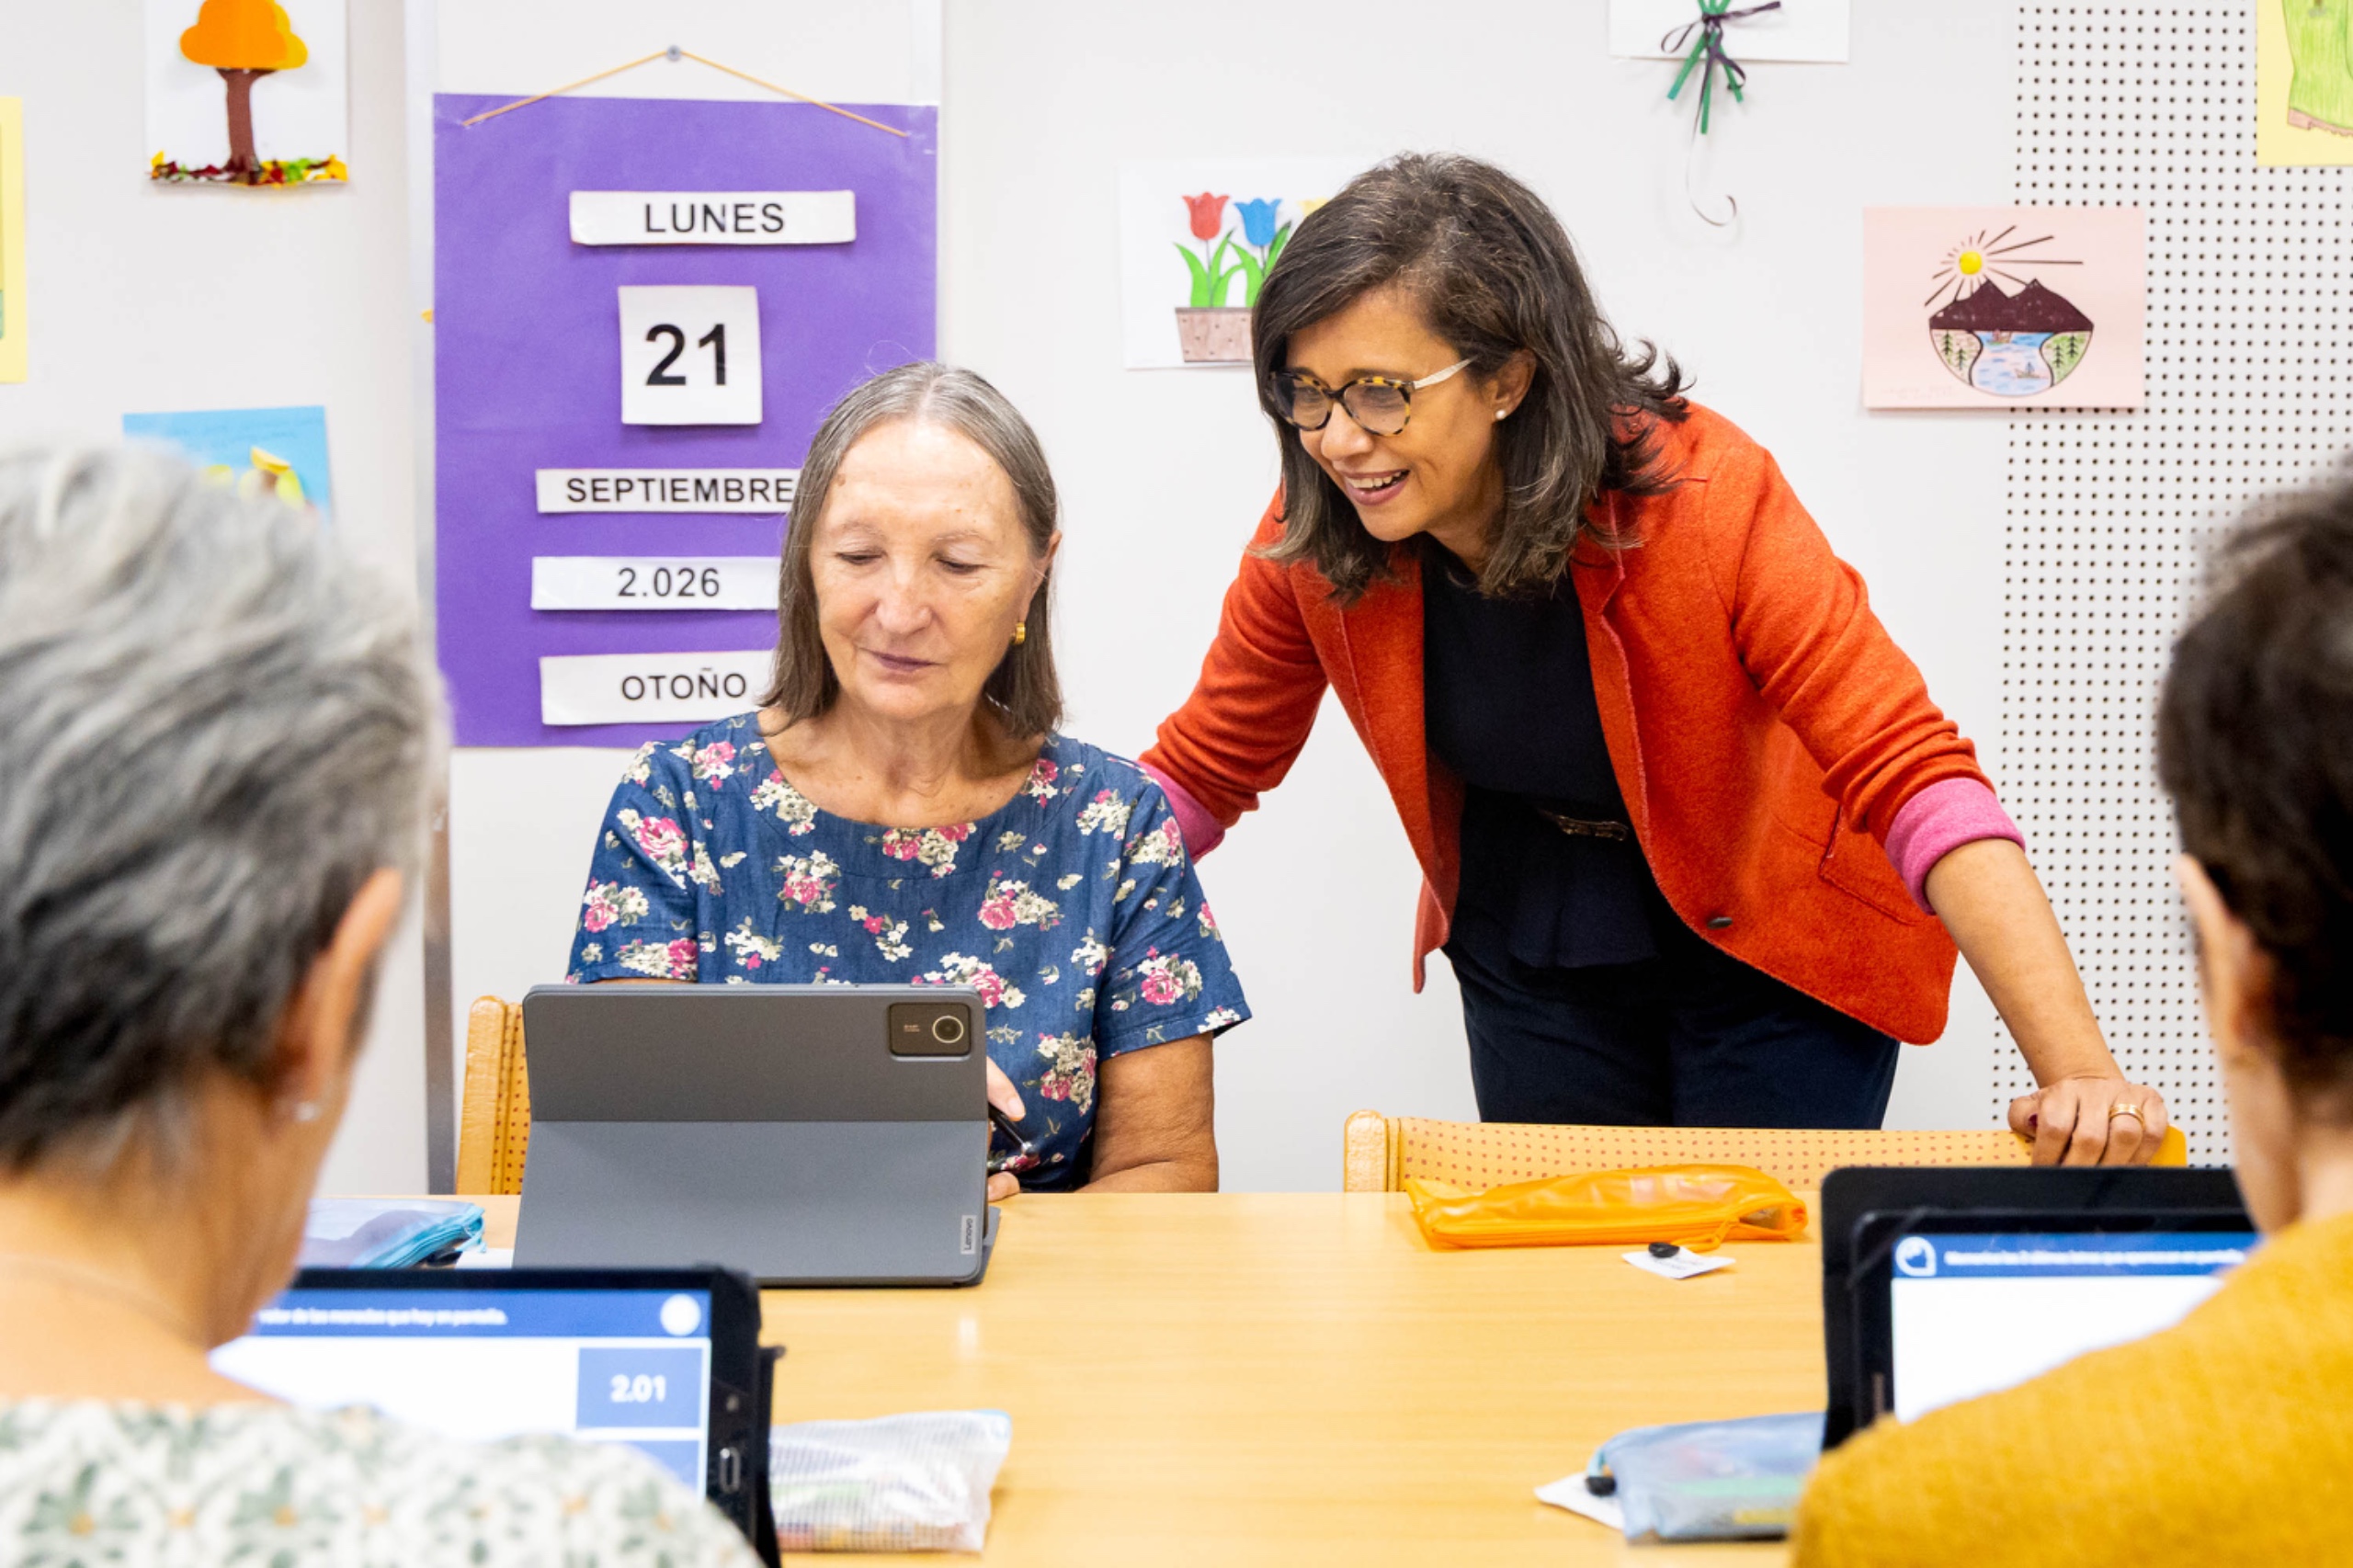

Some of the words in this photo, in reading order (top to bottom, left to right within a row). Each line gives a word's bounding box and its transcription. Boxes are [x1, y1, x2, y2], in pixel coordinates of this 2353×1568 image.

[646, 204, 783, 233] LUNES
[646, 324, 725, 385] 21
[568, 478, 791, 502] SEPTIEMBRE
[619, 567, 719, 597] 2.026
[622, 666, 745, 700] OTOÑO
[964, 1218, 973, 1251] Lenovo
[609, 1373, 666, 1403] 2.01
